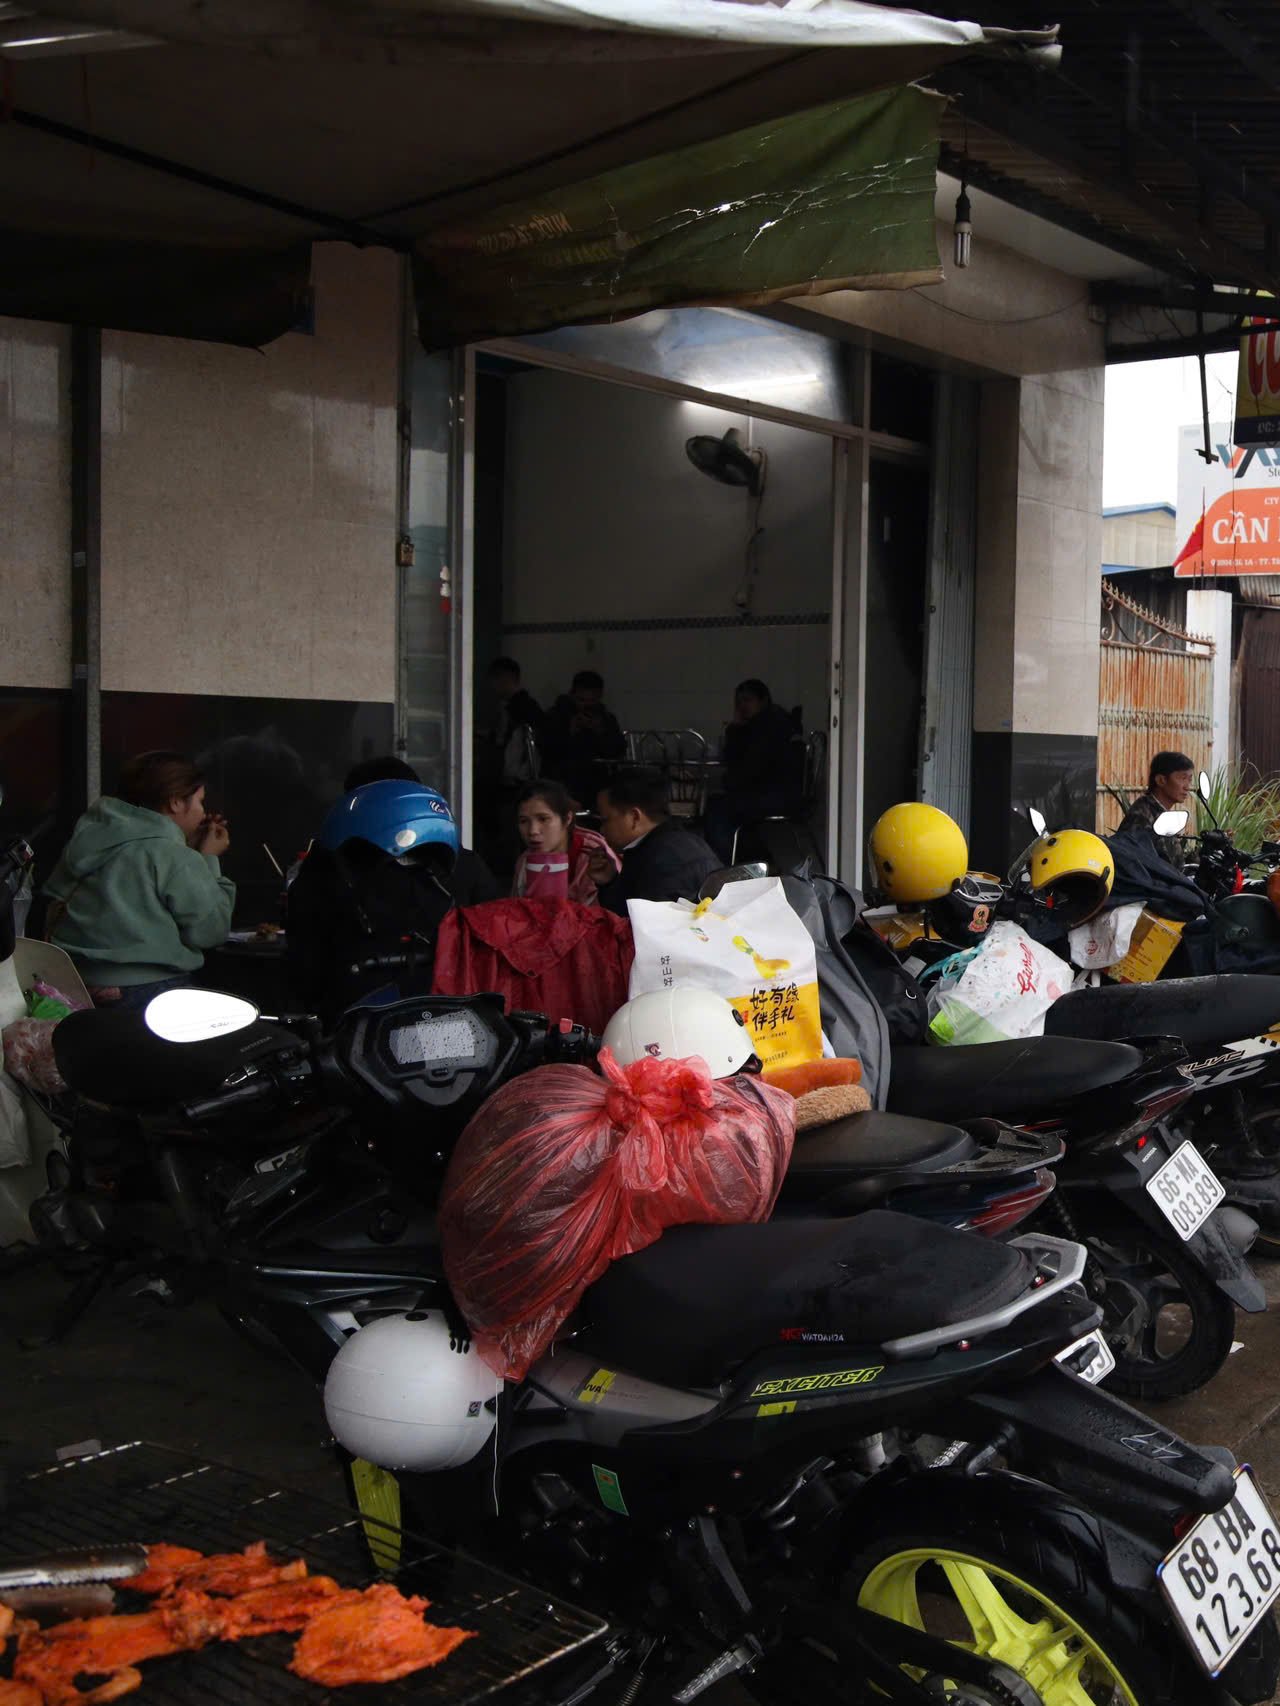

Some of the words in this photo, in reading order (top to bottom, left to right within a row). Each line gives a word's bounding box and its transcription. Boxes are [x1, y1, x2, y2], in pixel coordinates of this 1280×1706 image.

[1212, 508, 1269, 545] CẦN
[1156, 1151, 1200, 1204] 66-MA
[1171, 1173, 1219, 1232] 083.89
[750, 1365, 885, 1397] EXCITER
[1177, 1496, 1256, 1600] 68-BA
